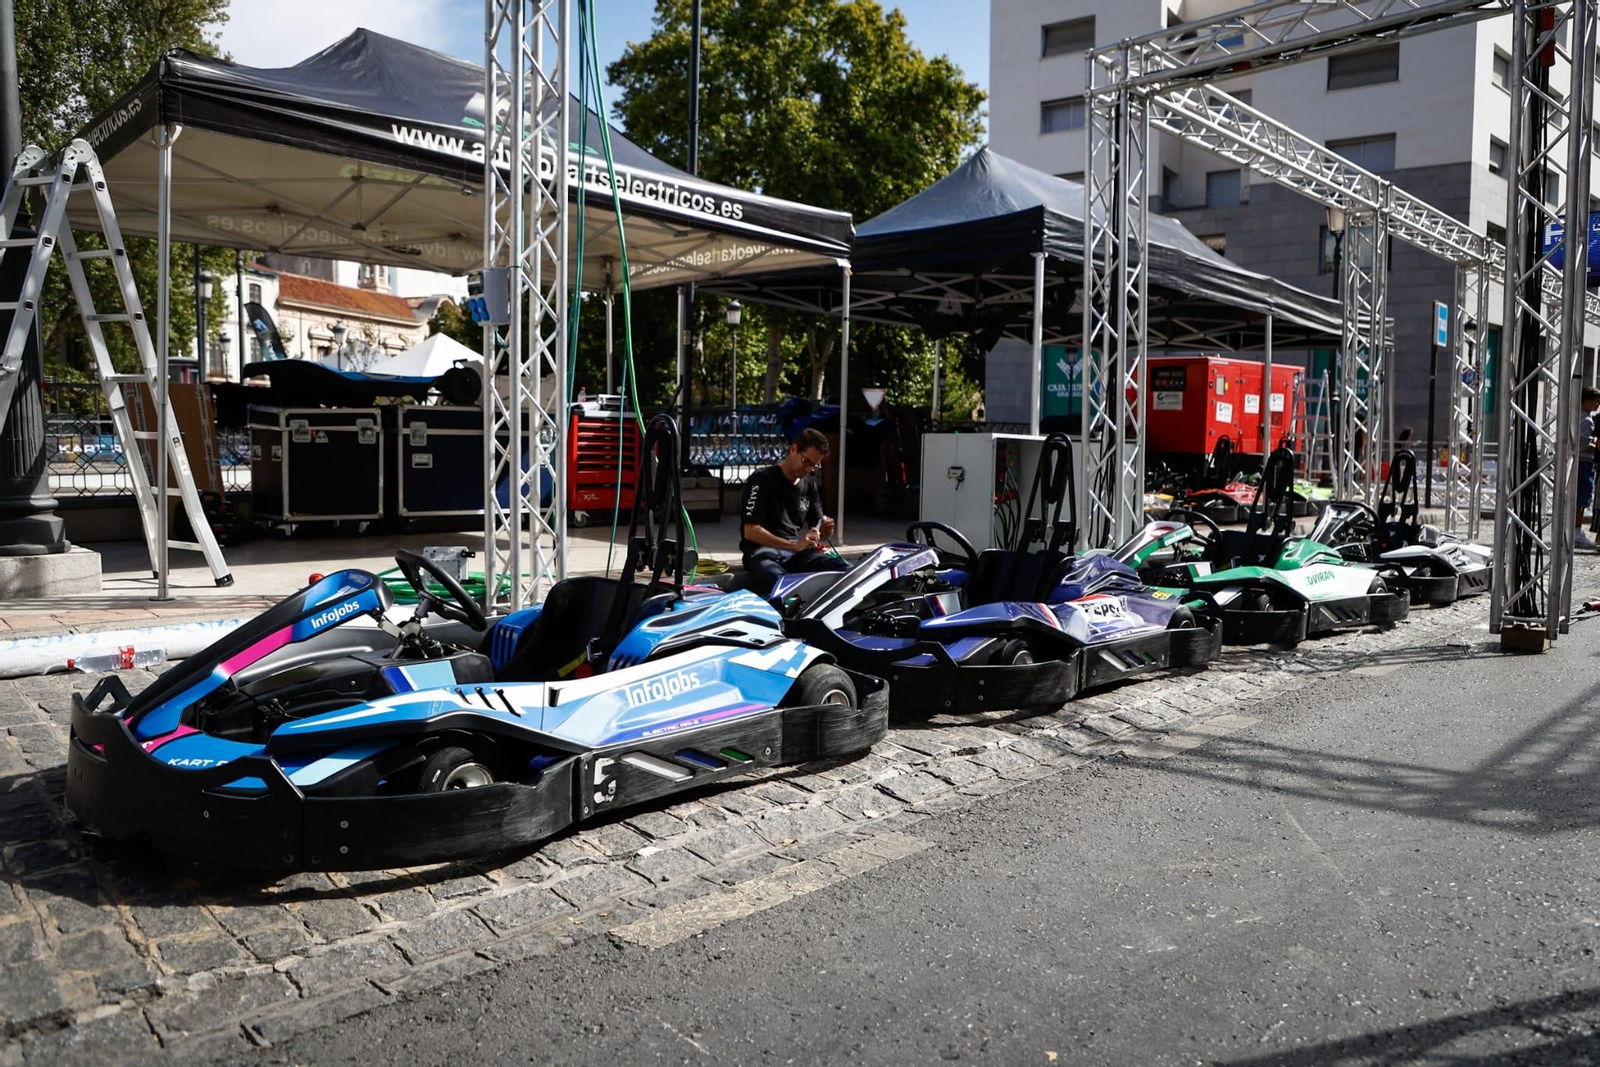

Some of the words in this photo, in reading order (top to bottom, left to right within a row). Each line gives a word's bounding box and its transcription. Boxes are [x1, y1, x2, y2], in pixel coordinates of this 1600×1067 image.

[311, 600, 360, 629] InfoJobs
[624, 671, 700, 708] InfoJobs
[167, 758, 214, 767] KART
